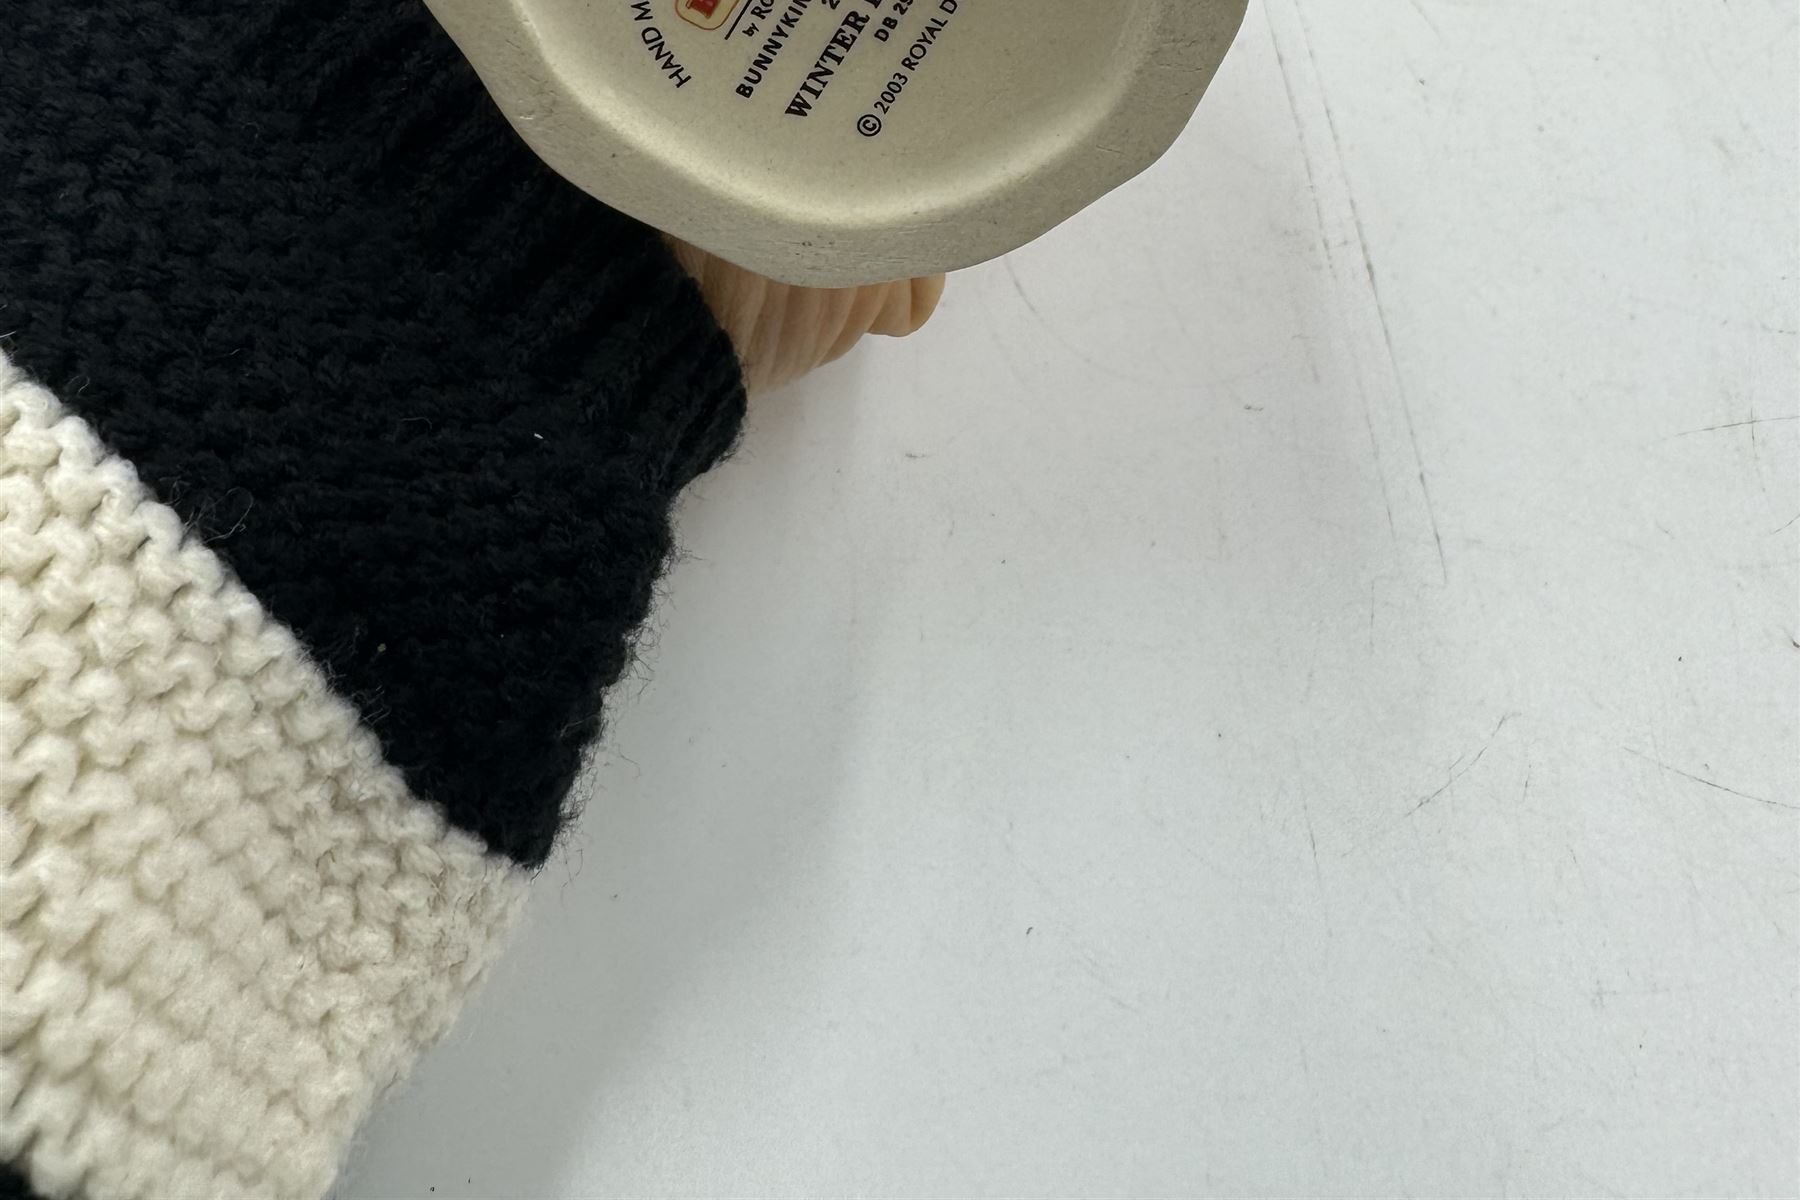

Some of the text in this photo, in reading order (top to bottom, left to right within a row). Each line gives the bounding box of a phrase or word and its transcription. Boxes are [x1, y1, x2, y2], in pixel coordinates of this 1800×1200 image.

[640, 26, 693, 90] HAND
[741, 21, 761, 38] by
[874, 16, 900, 43] DB
[784, 10, 870, 119] WINTER
[873, 73, 910, 115] 2003
[901, 14, 949, 72] ROYAL
